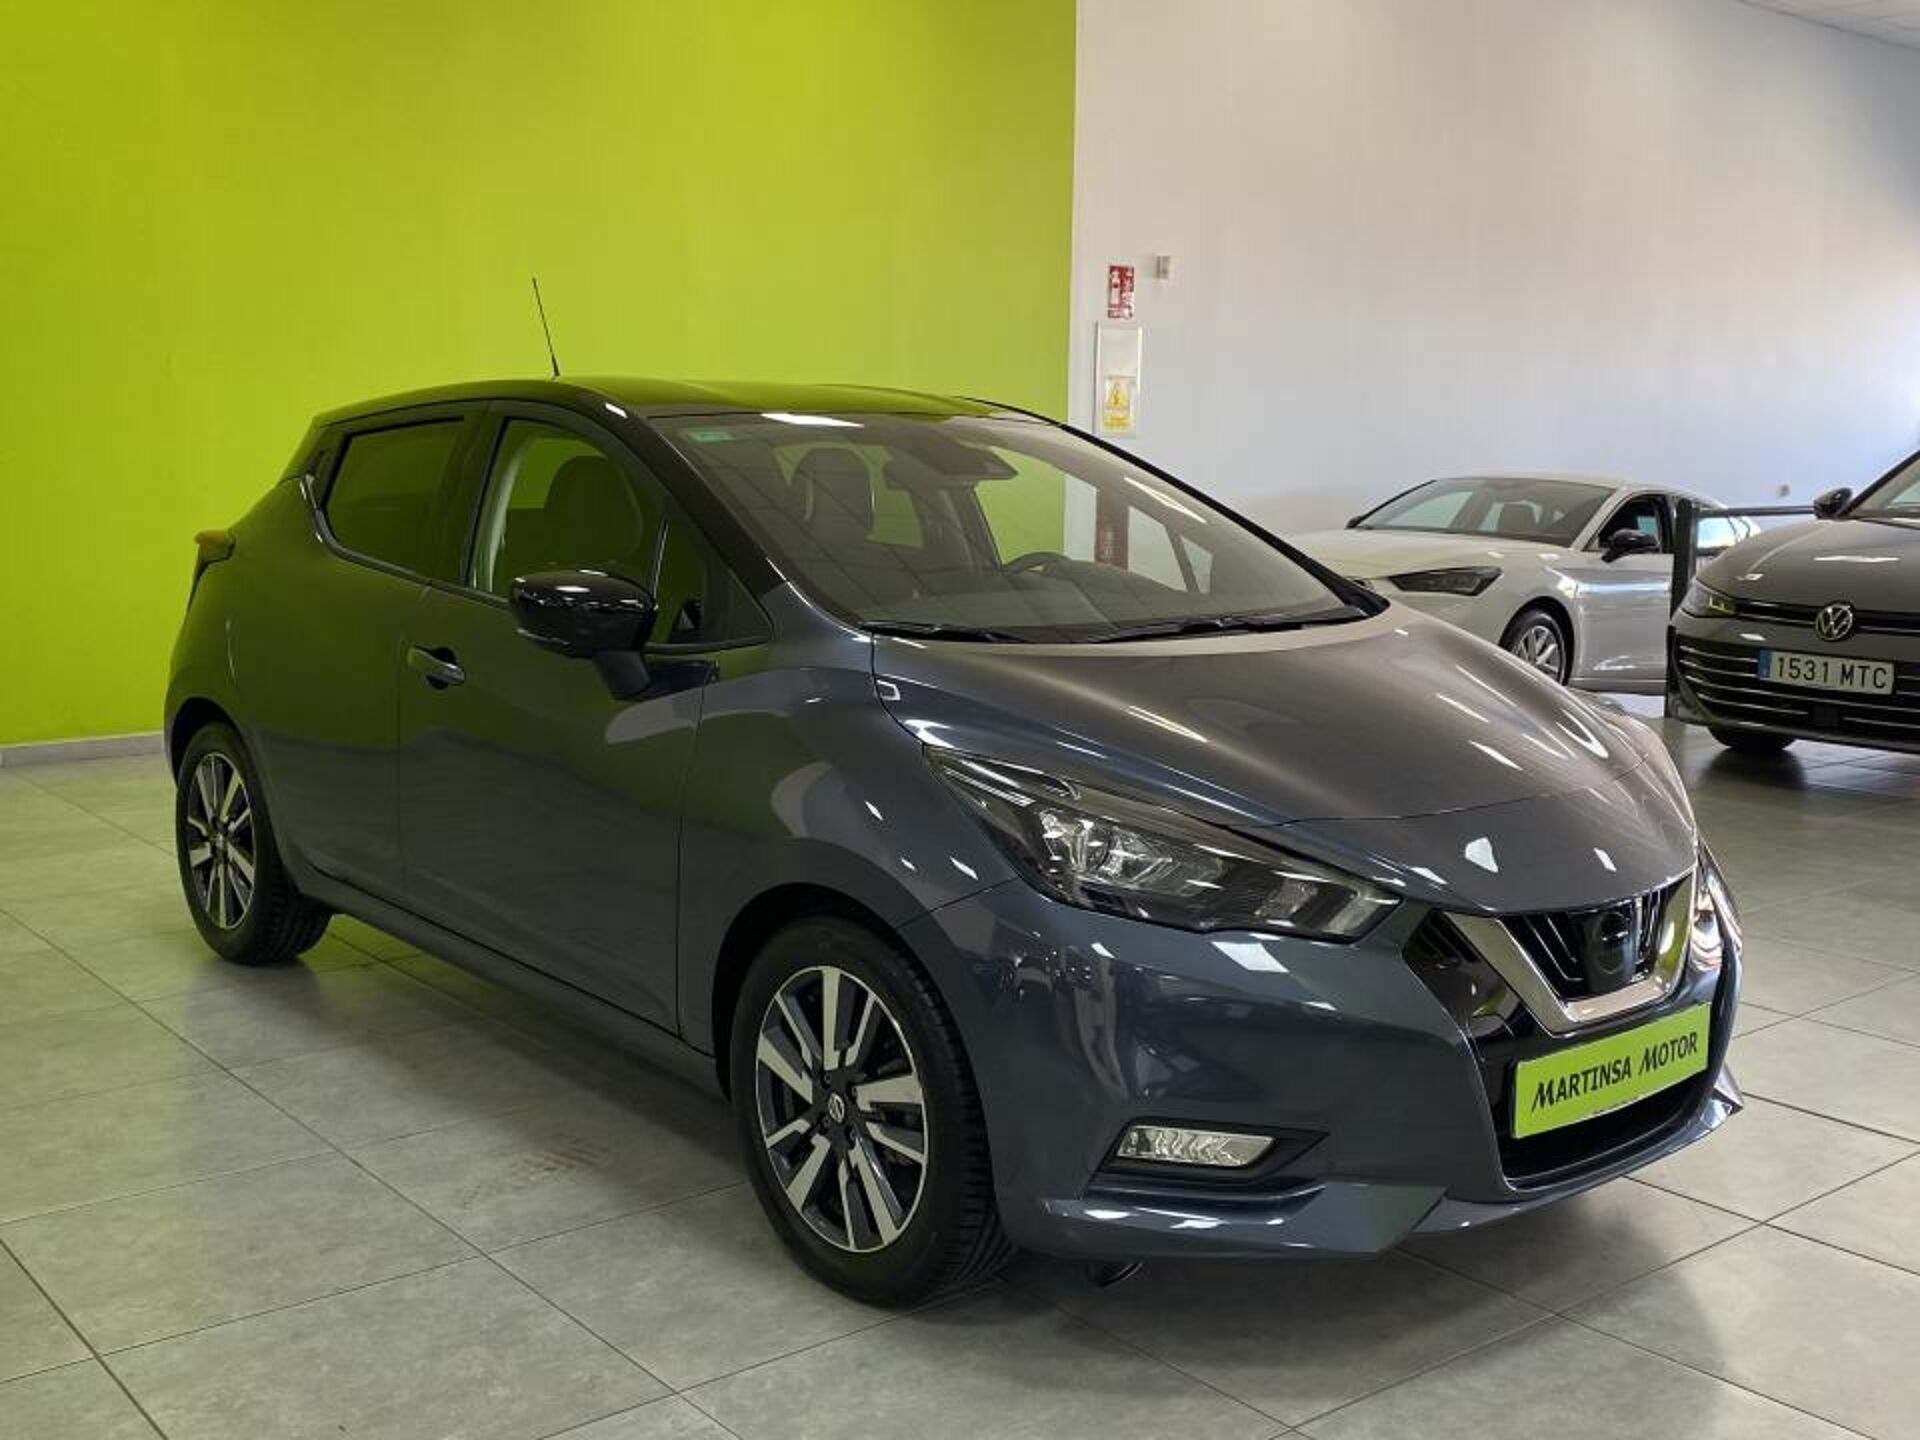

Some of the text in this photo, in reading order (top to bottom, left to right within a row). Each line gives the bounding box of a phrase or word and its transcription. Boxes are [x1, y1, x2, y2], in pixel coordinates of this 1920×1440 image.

[1778, 657, 1887, 689] 1531 MTC
[1531, 1032, 1697, 1113] MARTINSA MOTOR
